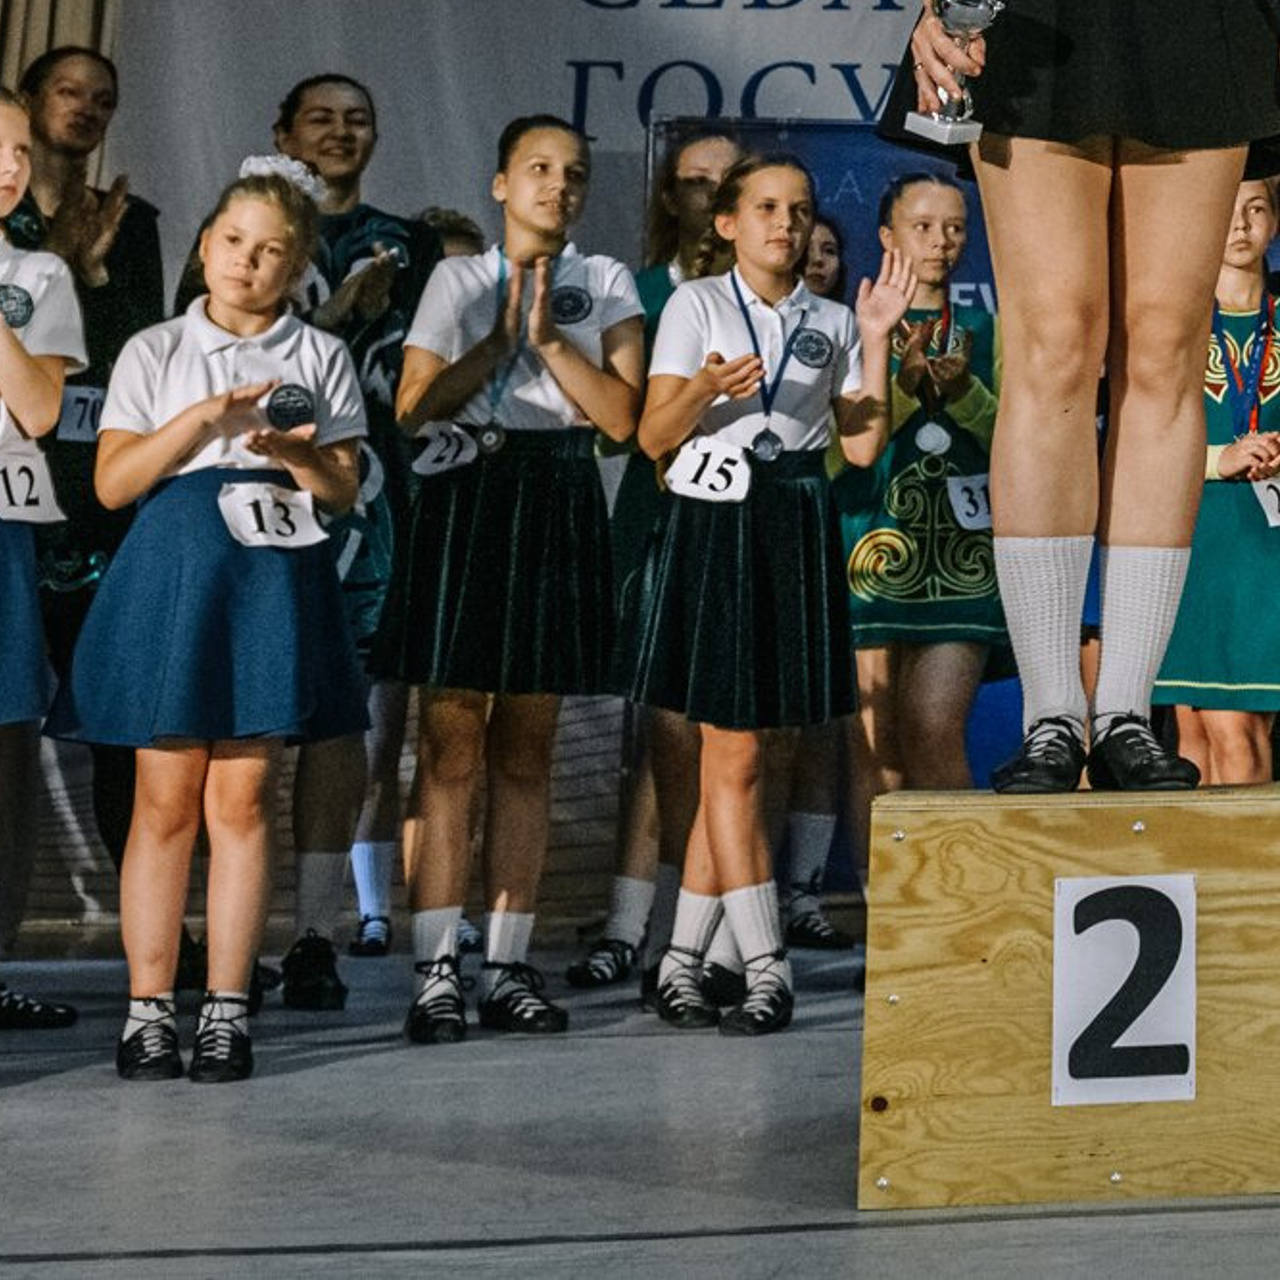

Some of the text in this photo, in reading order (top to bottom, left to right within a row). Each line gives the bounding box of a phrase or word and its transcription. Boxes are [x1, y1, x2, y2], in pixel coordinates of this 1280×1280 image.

[566, 60, 904, 142] ГОСУ
[0, 465, 40, 506] 12
[690, 451, 738, 492] 15
[248, 499, 297, 538] 13
[1066, 884, 1191, 1080] 2
